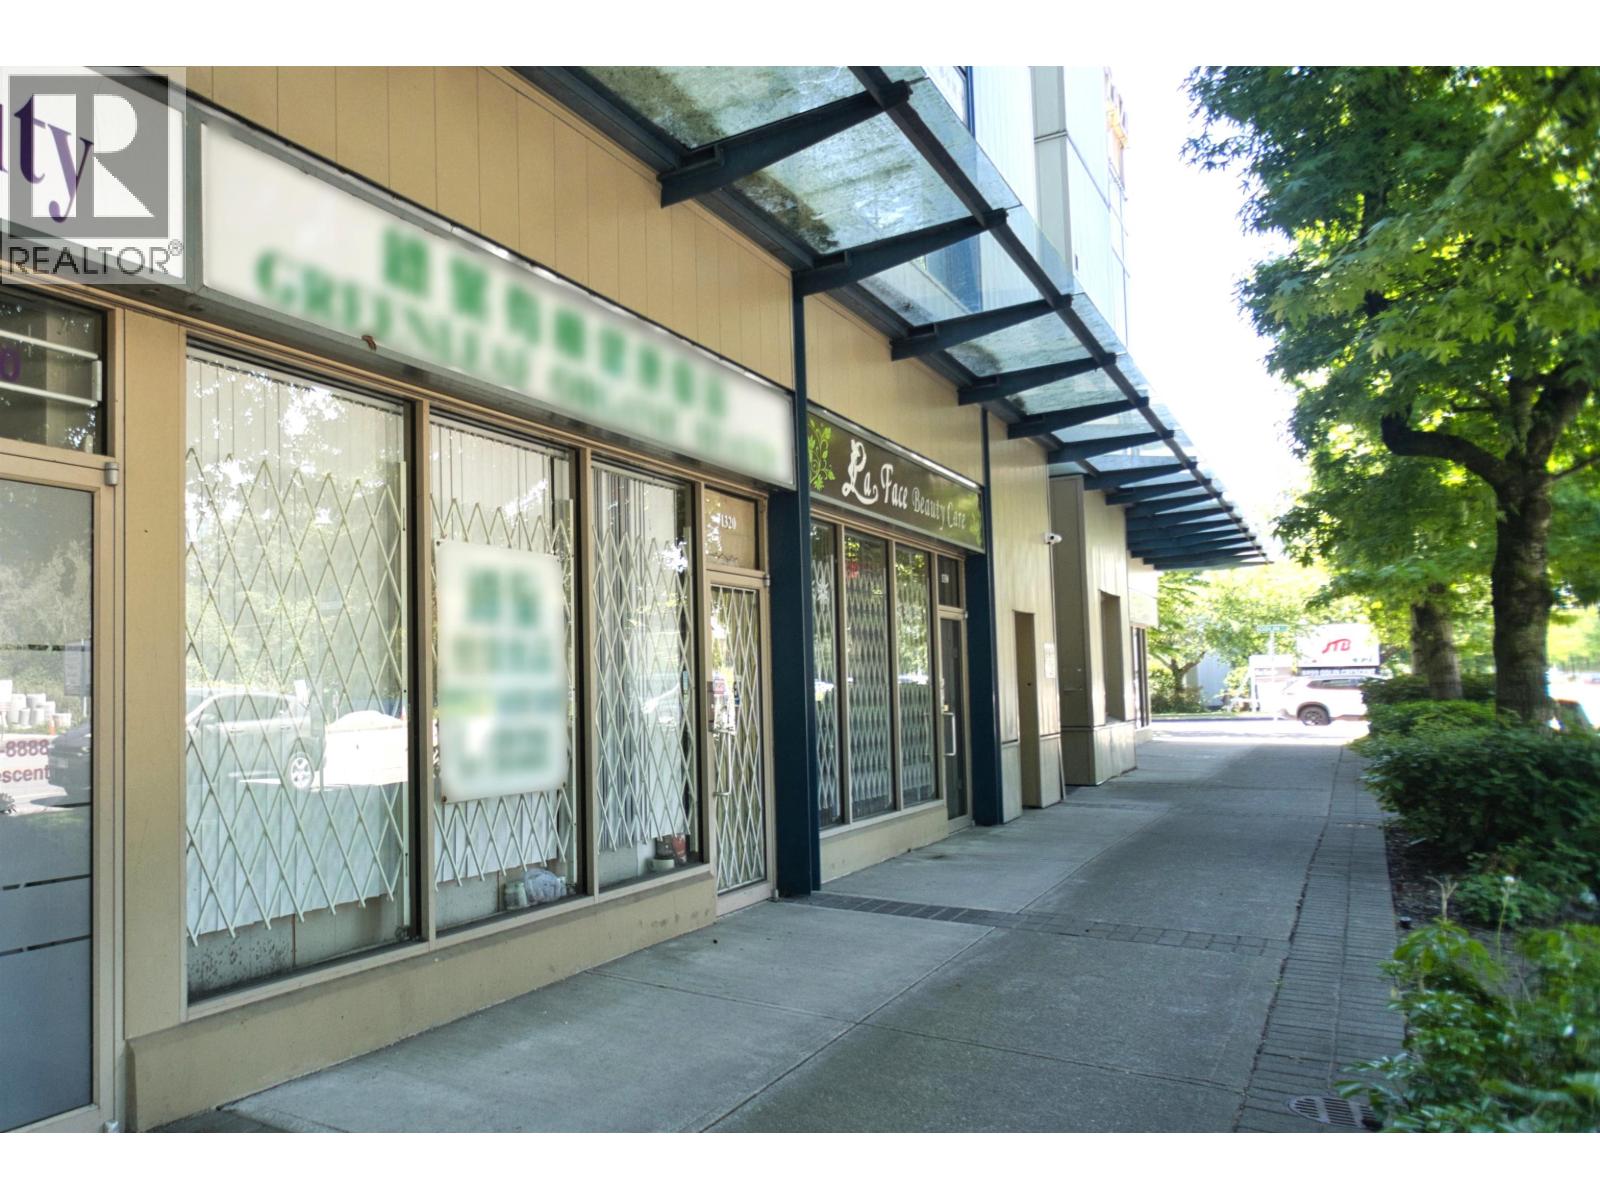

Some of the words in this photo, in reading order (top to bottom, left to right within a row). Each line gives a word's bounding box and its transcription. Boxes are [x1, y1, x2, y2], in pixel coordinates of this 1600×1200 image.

[0, 94, 95, 223] ty
[841, 439, 879, 505] La
[881, 463, 909, 510] Face
[911, 487, 946, 531] Beauty
[947, 502, 967, 530] Care
[0, 764, 51, 784] scent
